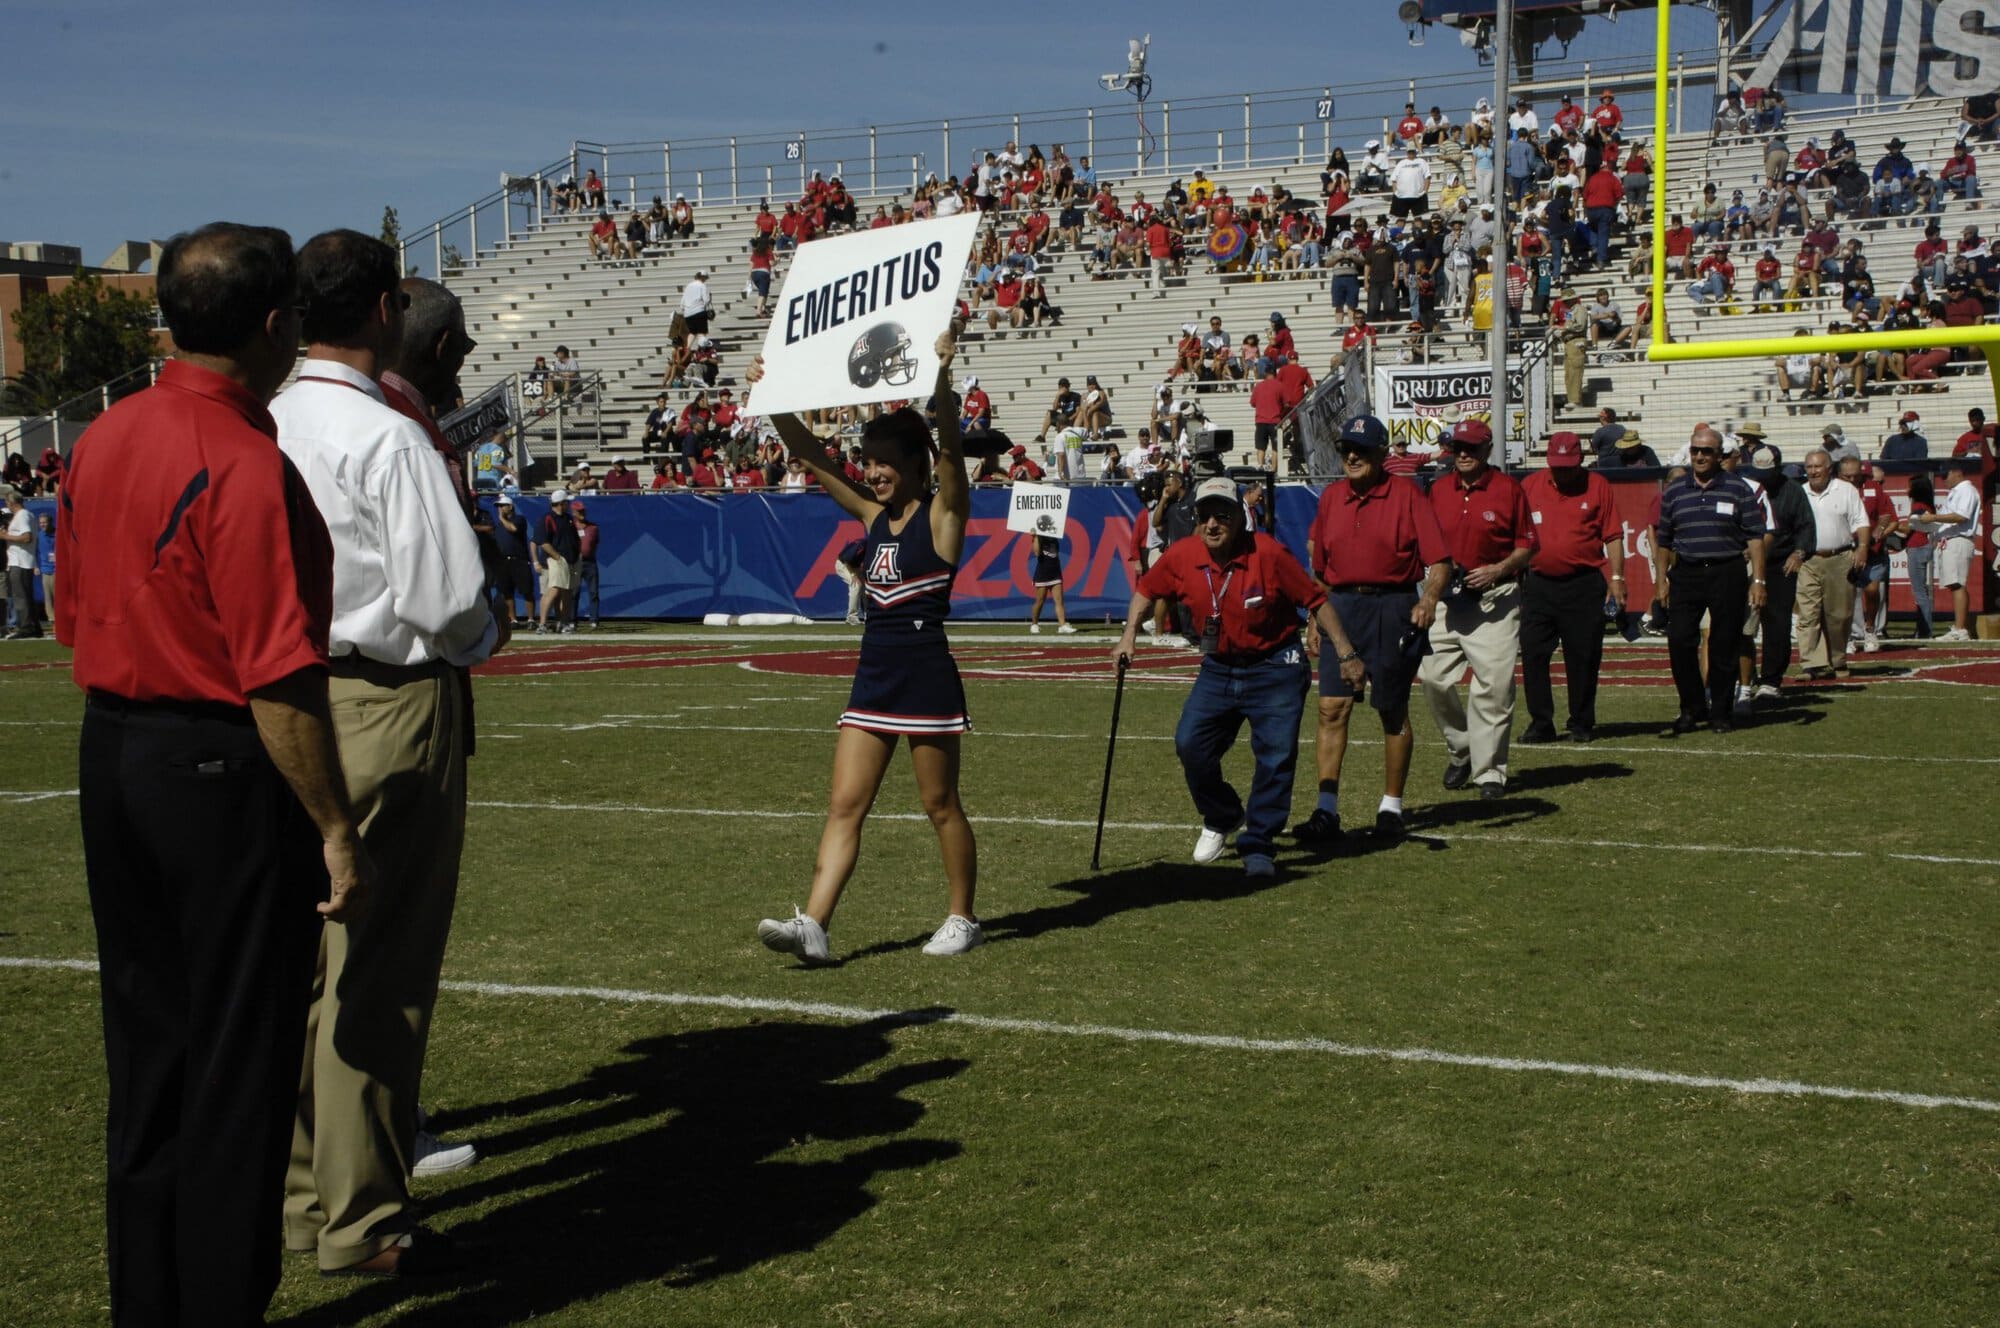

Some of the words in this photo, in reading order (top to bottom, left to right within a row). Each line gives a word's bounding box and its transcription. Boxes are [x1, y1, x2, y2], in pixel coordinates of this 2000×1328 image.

[1318, 100, 1332, 118] 27
[786, 142, 799, 159] 26
[785, 241, 942, 346] EMERITUS
[523, 381, 543, 395] 26
[1394, 374, 1523, 404] BRUEGGE'S
[1016, 494, 1062, 510] EMERITUS
[866, 543, 902, 584] A
